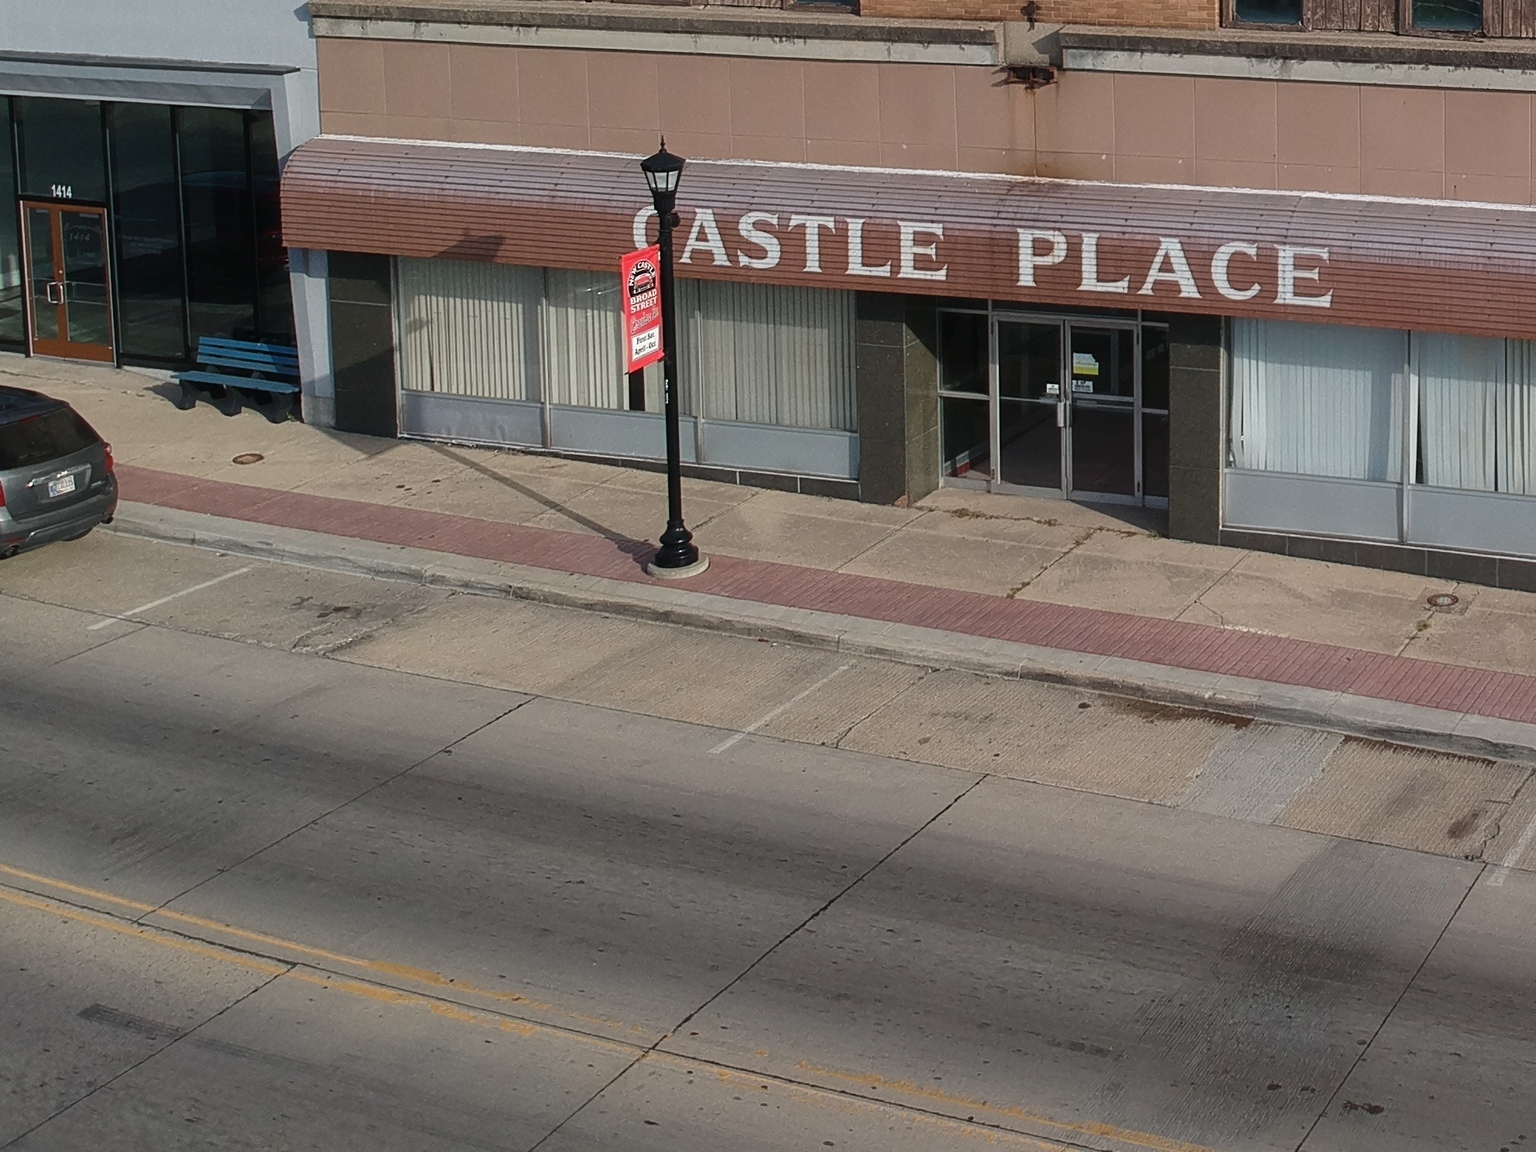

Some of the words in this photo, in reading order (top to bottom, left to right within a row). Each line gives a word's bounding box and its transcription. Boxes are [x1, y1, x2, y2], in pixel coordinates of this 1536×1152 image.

[51, 184, 72, 199] 1414
[633, 205, 949, 281] CASTLE
[1016, 228, 1334, 308] PLACE
[628, 266, 638, 287] NEW
[637, 261, 656, 279] CASTLE
[630, 289, 658, 305] BROAD
[630, 296, 658, 314] STREET
[634, 344, 646, 356] April
